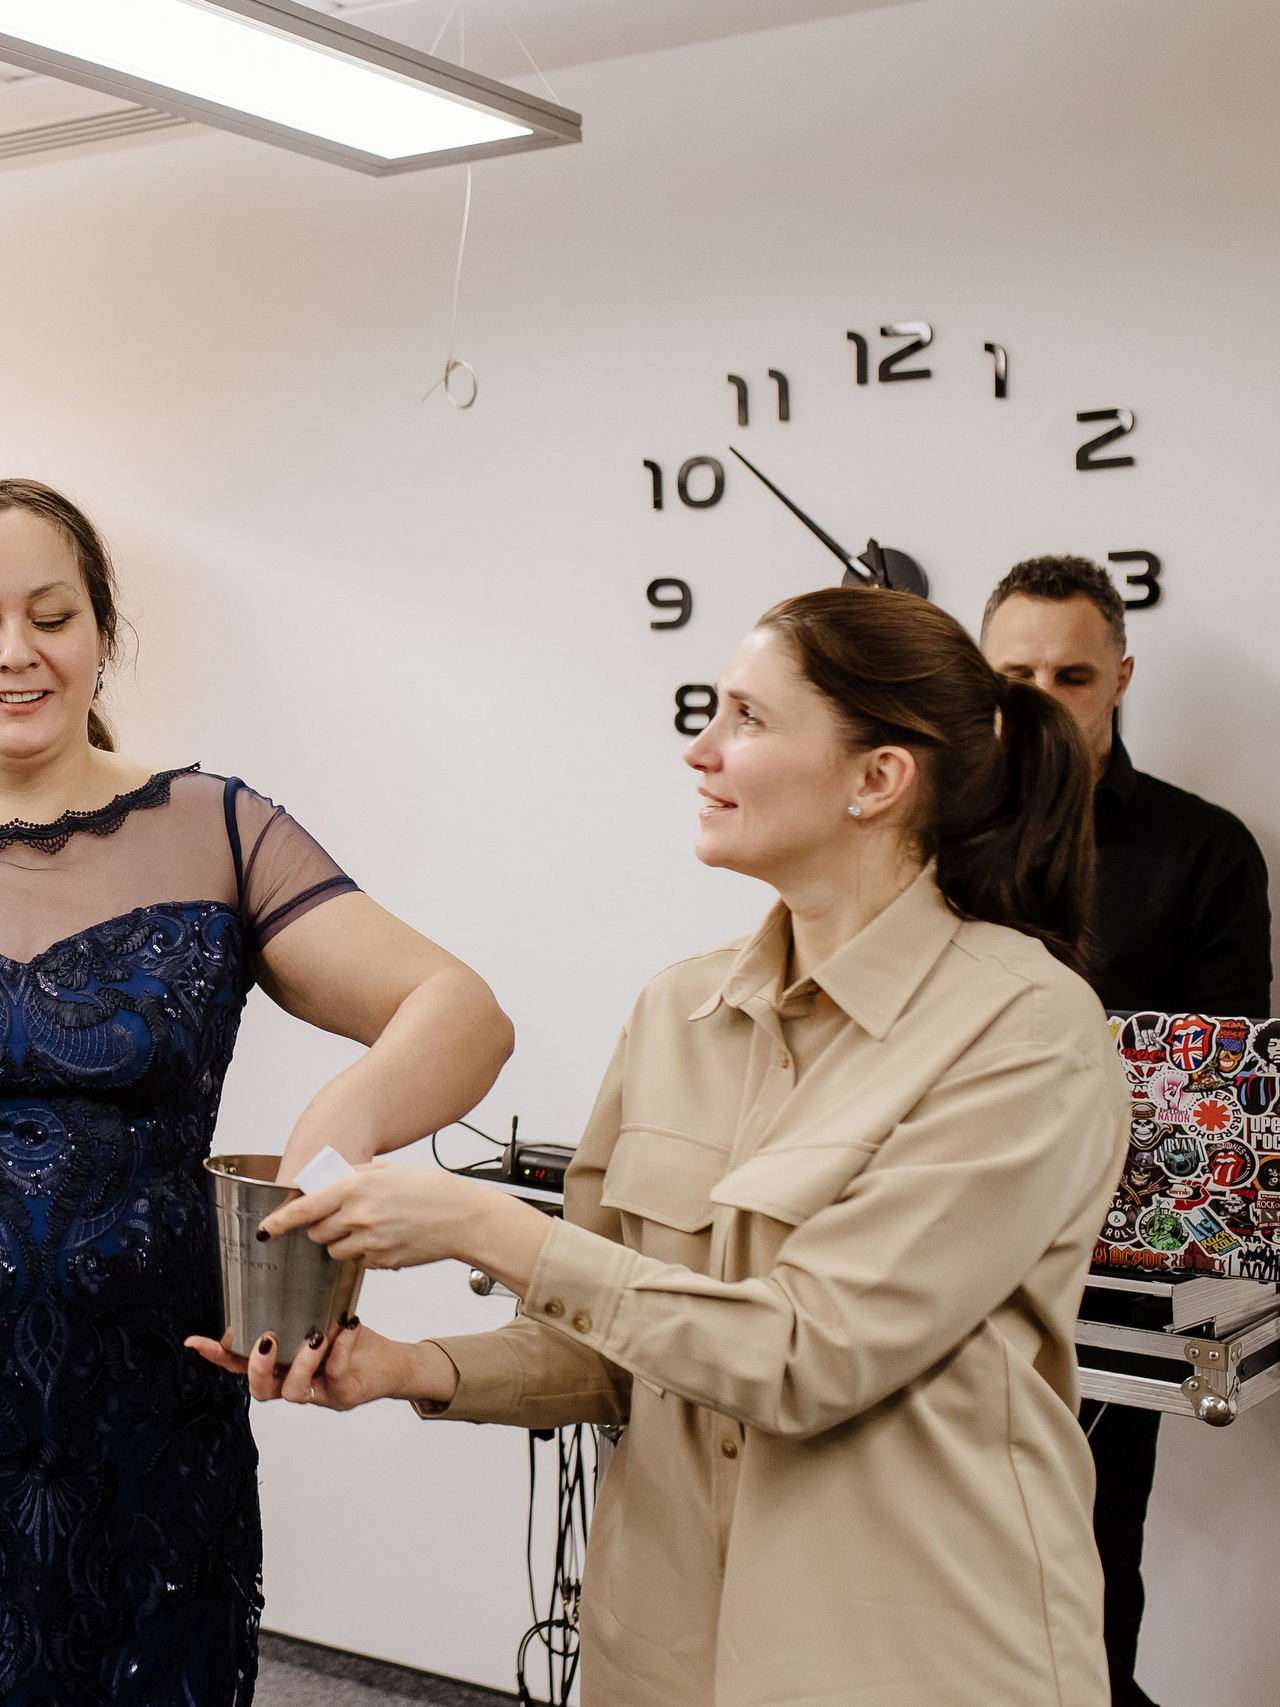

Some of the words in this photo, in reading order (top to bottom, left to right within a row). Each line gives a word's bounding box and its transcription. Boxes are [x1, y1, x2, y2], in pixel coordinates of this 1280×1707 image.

[846, 320, 933, 386] 12
[984, 342, 1009, 399] 1
[727, 368, 791, 427] 11
[1075, 407, 1135, 471] 2
[643, 455, 726, 511] 10
[646, 577, 693, 630] 9
[1108, 550, 1162, 610] 3
[674, 684, 719, 736] 8
[1158, 1111, 1190, 1123] NATION
[1106, 1227, 1135, 1239] ROLL
